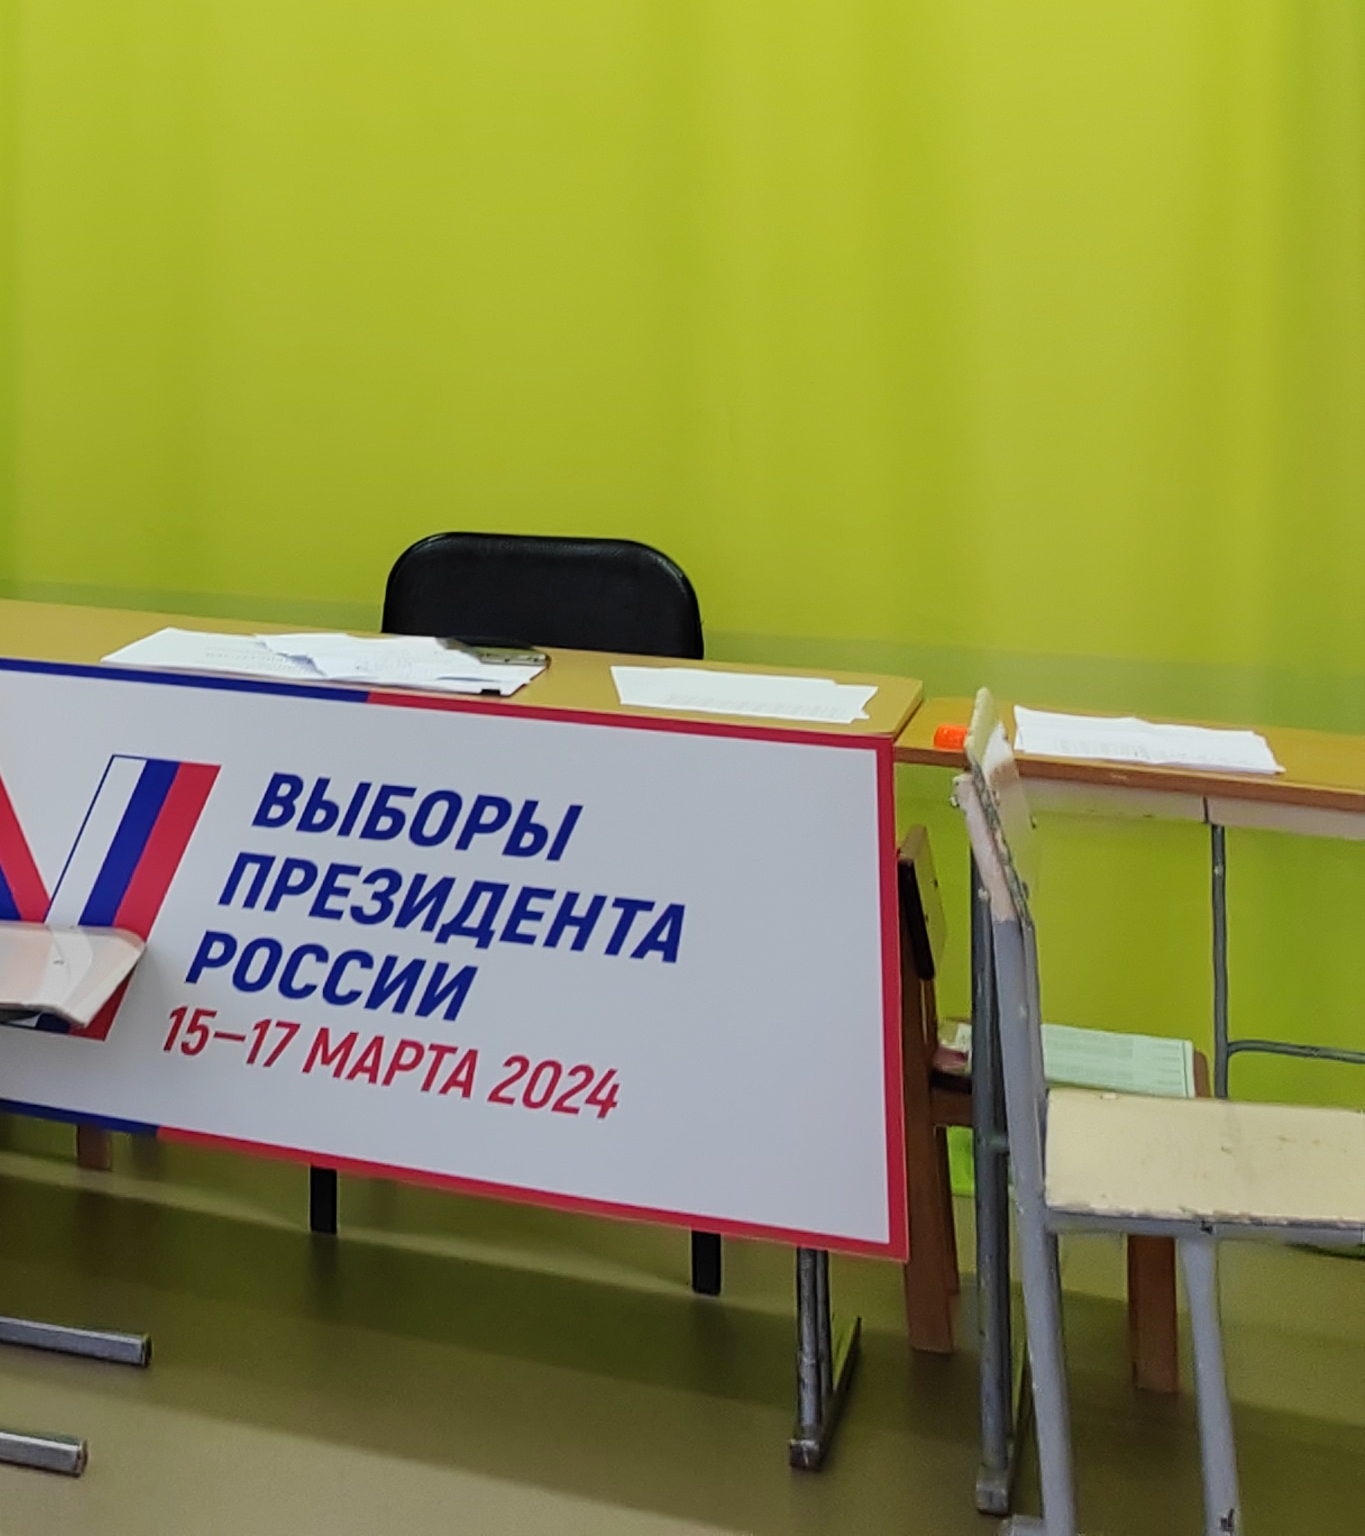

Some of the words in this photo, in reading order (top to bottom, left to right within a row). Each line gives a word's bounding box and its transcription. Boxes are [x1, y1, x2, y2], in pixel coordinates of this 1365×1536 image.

[250, 771, 584, 862] ВЫБОРЫ
[217, 851, 686, 964] ПРЕЗИДЕНТА
[184, 929, 480, 1023] РОССИИ
[301, 1024, 480, 1101] МАРТА
[486, 1053, 622, 1120] 2024
